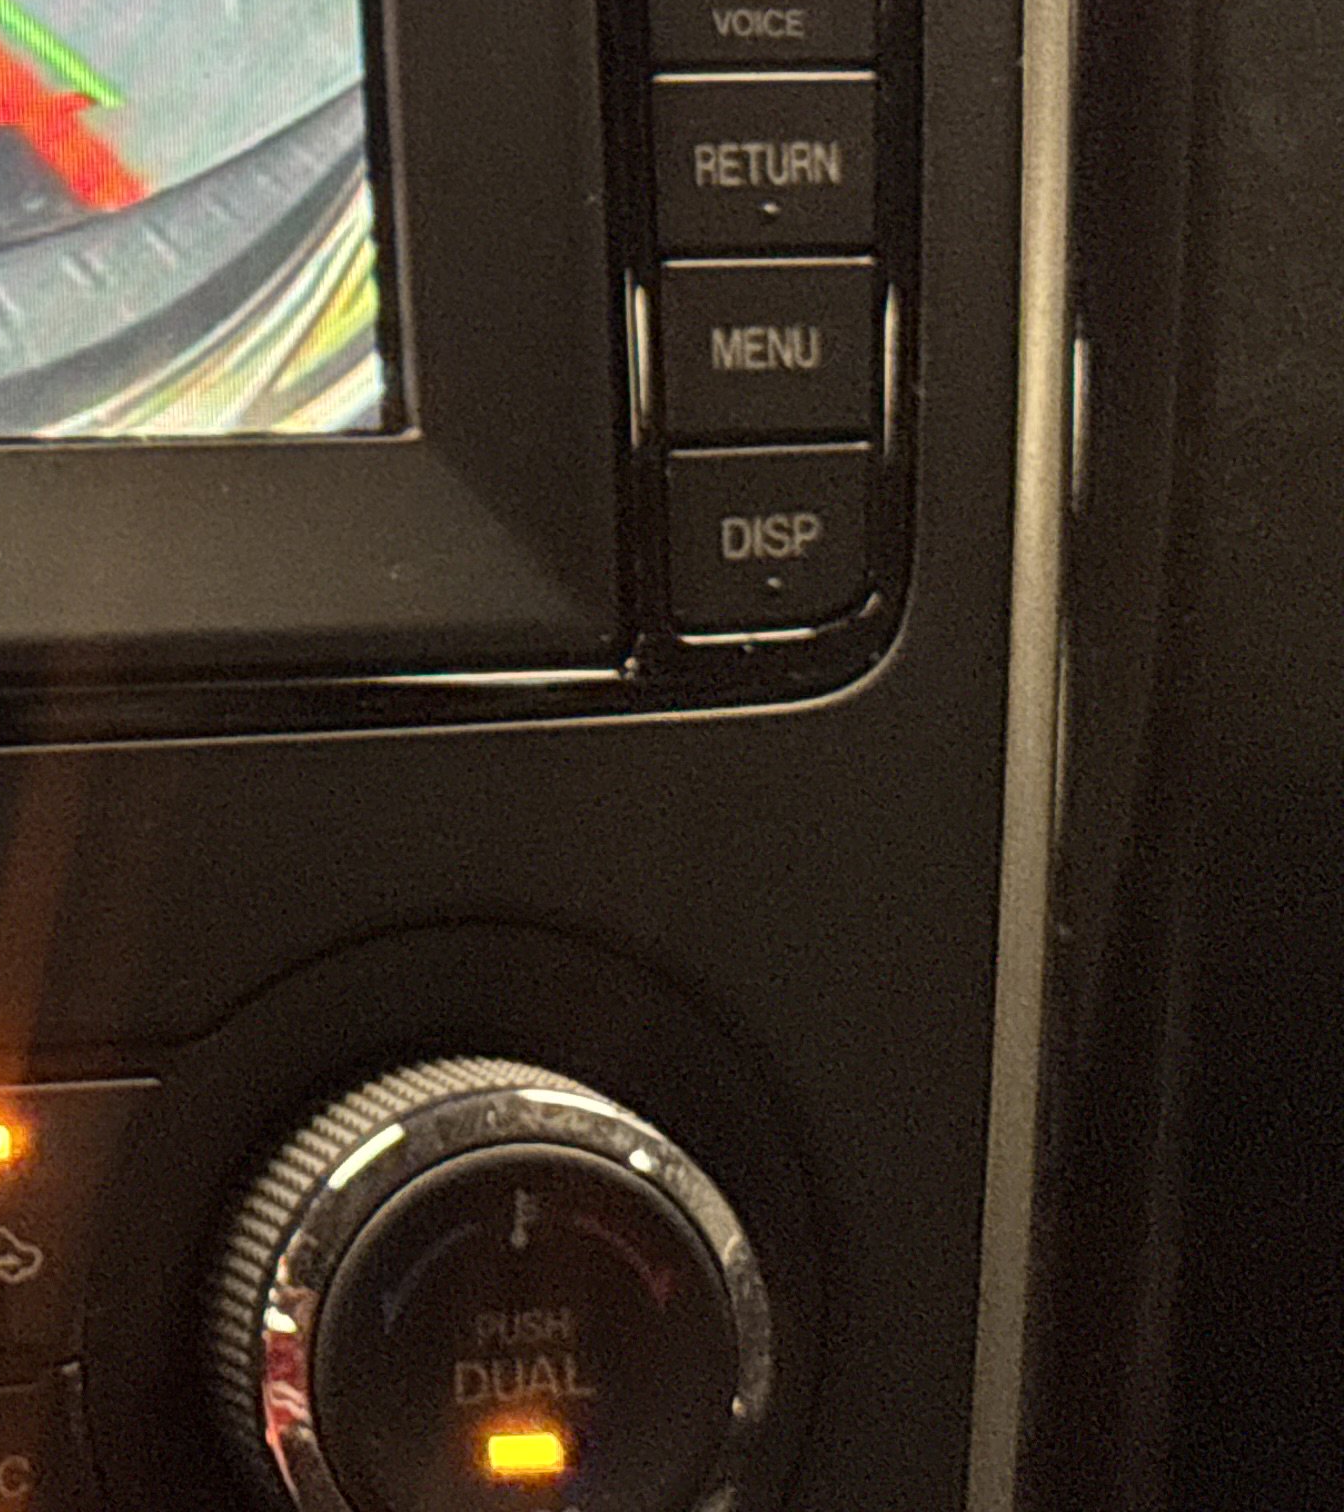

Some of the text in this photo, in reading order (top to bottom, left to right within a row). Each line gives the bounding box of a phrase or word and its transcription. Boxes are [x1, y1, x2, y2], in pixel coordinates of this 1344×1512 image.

[712, 8, 805, 39] VOICE
[694, 141, 841, 188] RETURN
[712, 327, 820, 371] MENU
[722, 515, 821, 561] DISP
[475, 1308, 574, 1343] PUSH
[454, 1354, 590, 1405] DUAL
